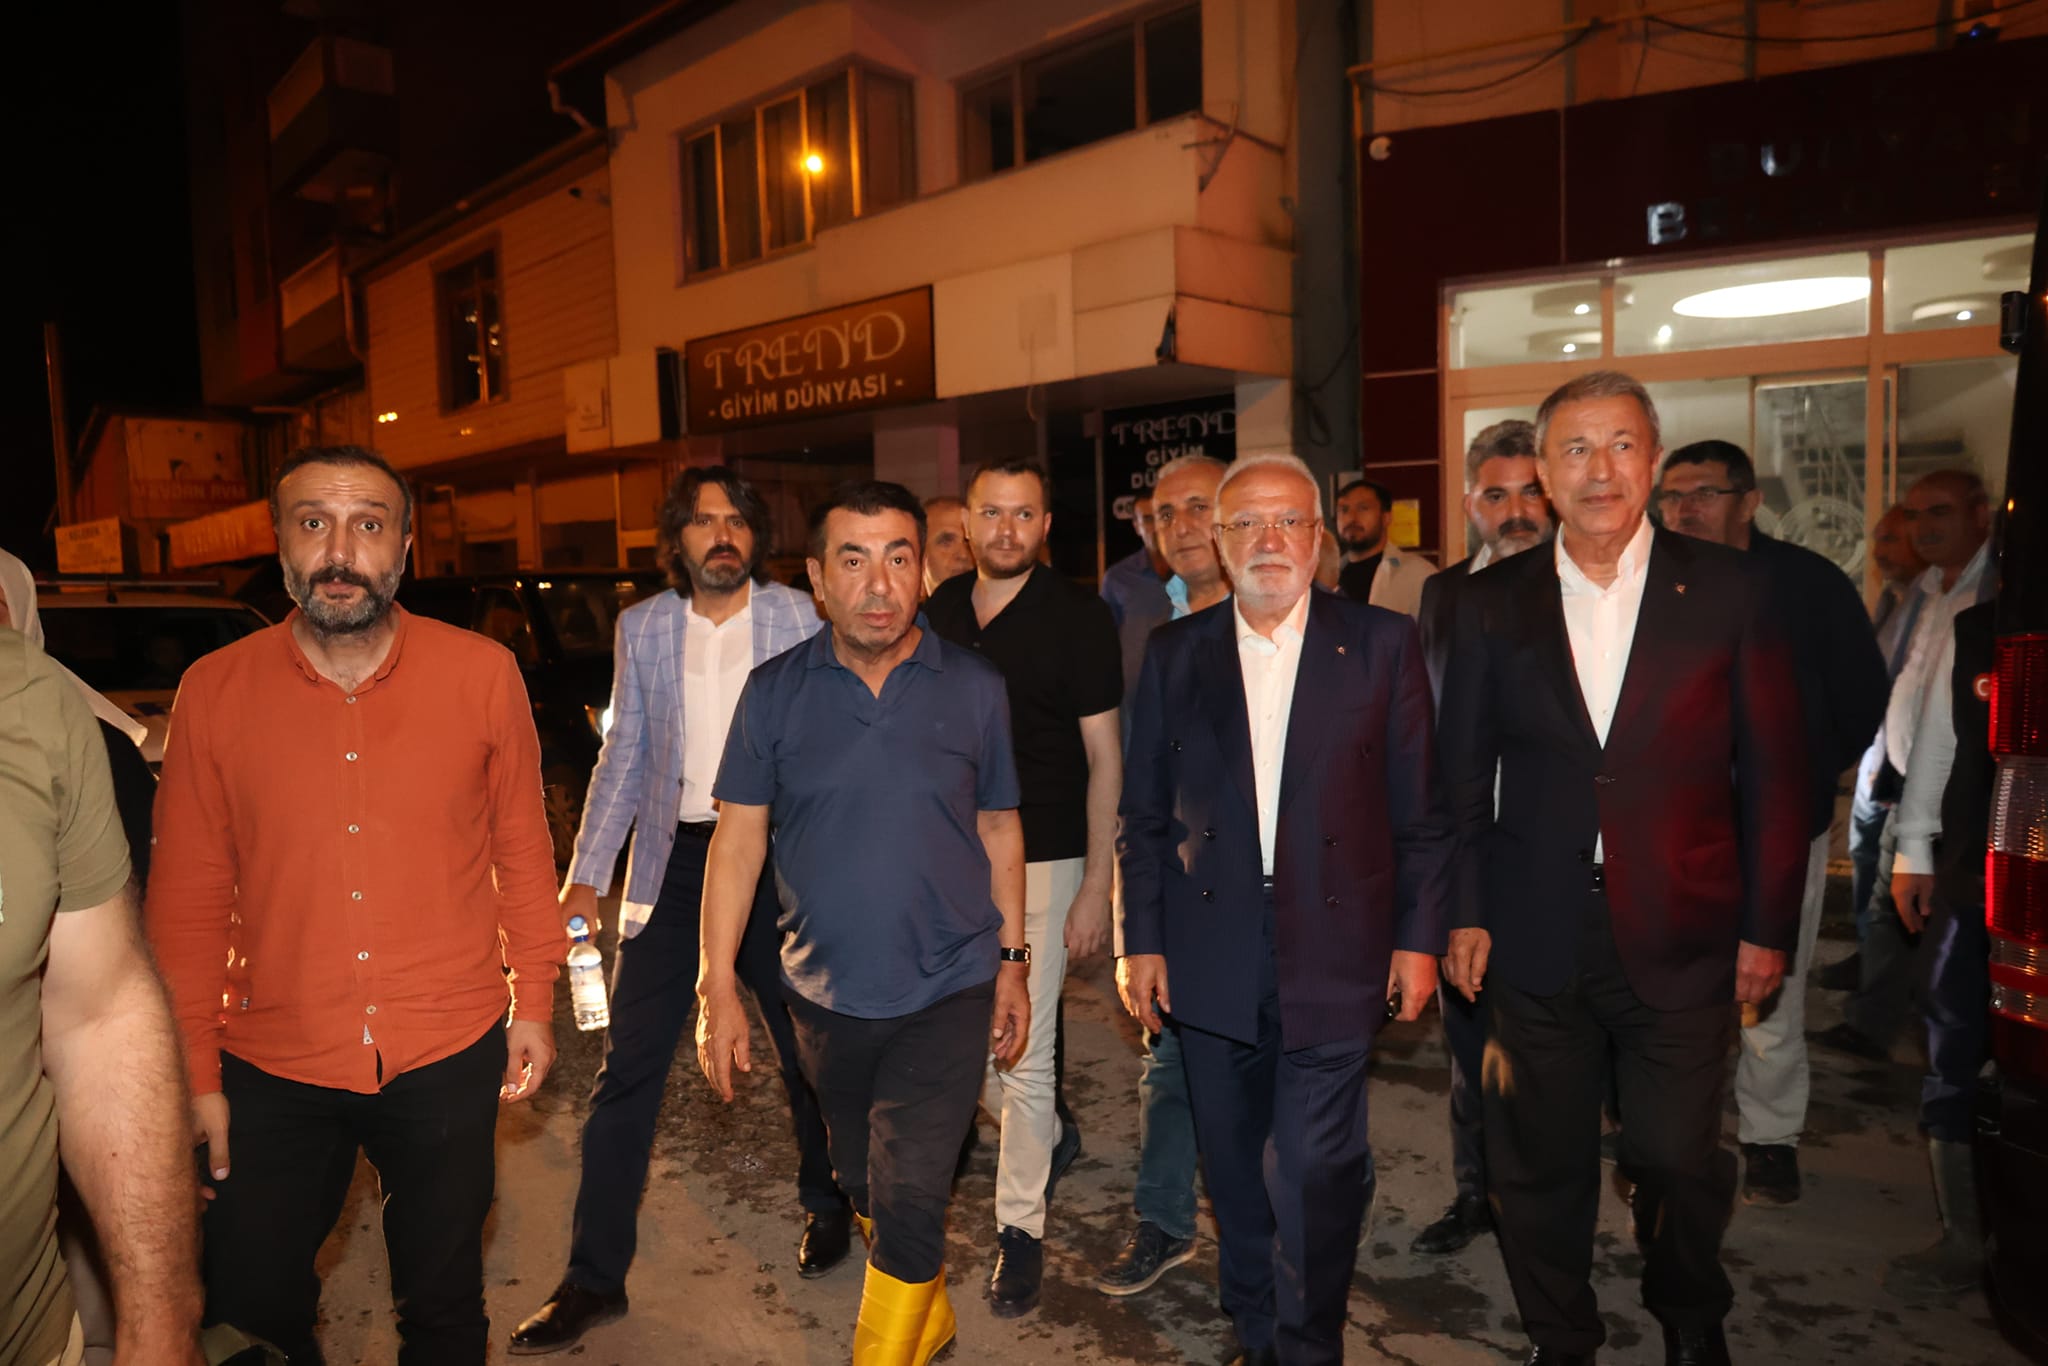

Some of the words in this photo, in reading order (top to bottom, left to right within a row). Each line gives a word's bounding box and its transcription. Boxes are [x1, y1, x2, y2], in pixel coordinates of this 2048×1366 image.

[703, 311, 906, 389] TREND
[720, 387, 778, 420] GİYİM
[785, 372, 887, 410] DÜNYASI
[1111, 409, 1236, 445] TREND
